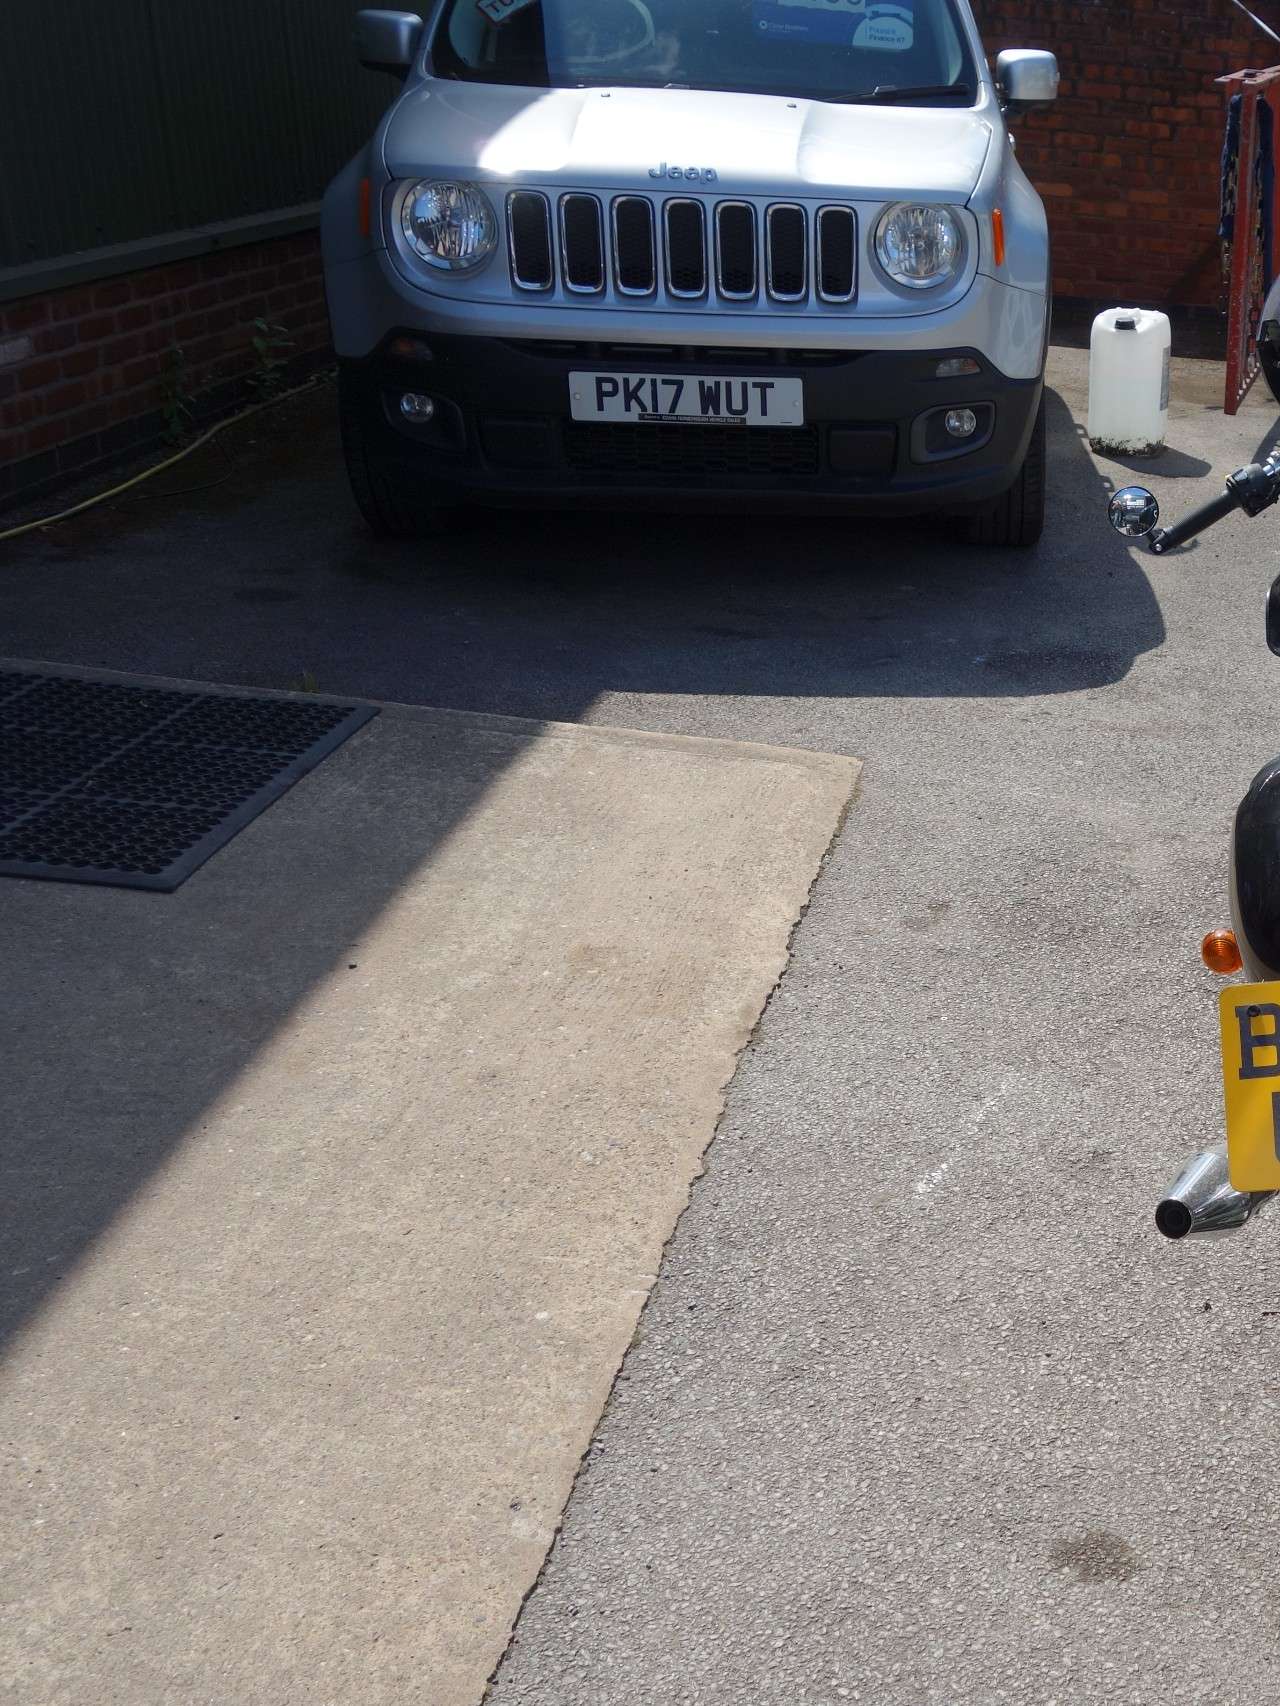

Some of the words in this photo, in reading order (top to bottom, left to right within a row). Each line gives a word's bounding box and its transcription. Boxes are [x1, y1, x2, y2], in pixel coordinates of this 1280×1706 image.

[648, 162, 718, 184] Jeep
[595, 376, 684, 414] PK17
[698, 380, 775, 416] WUT
